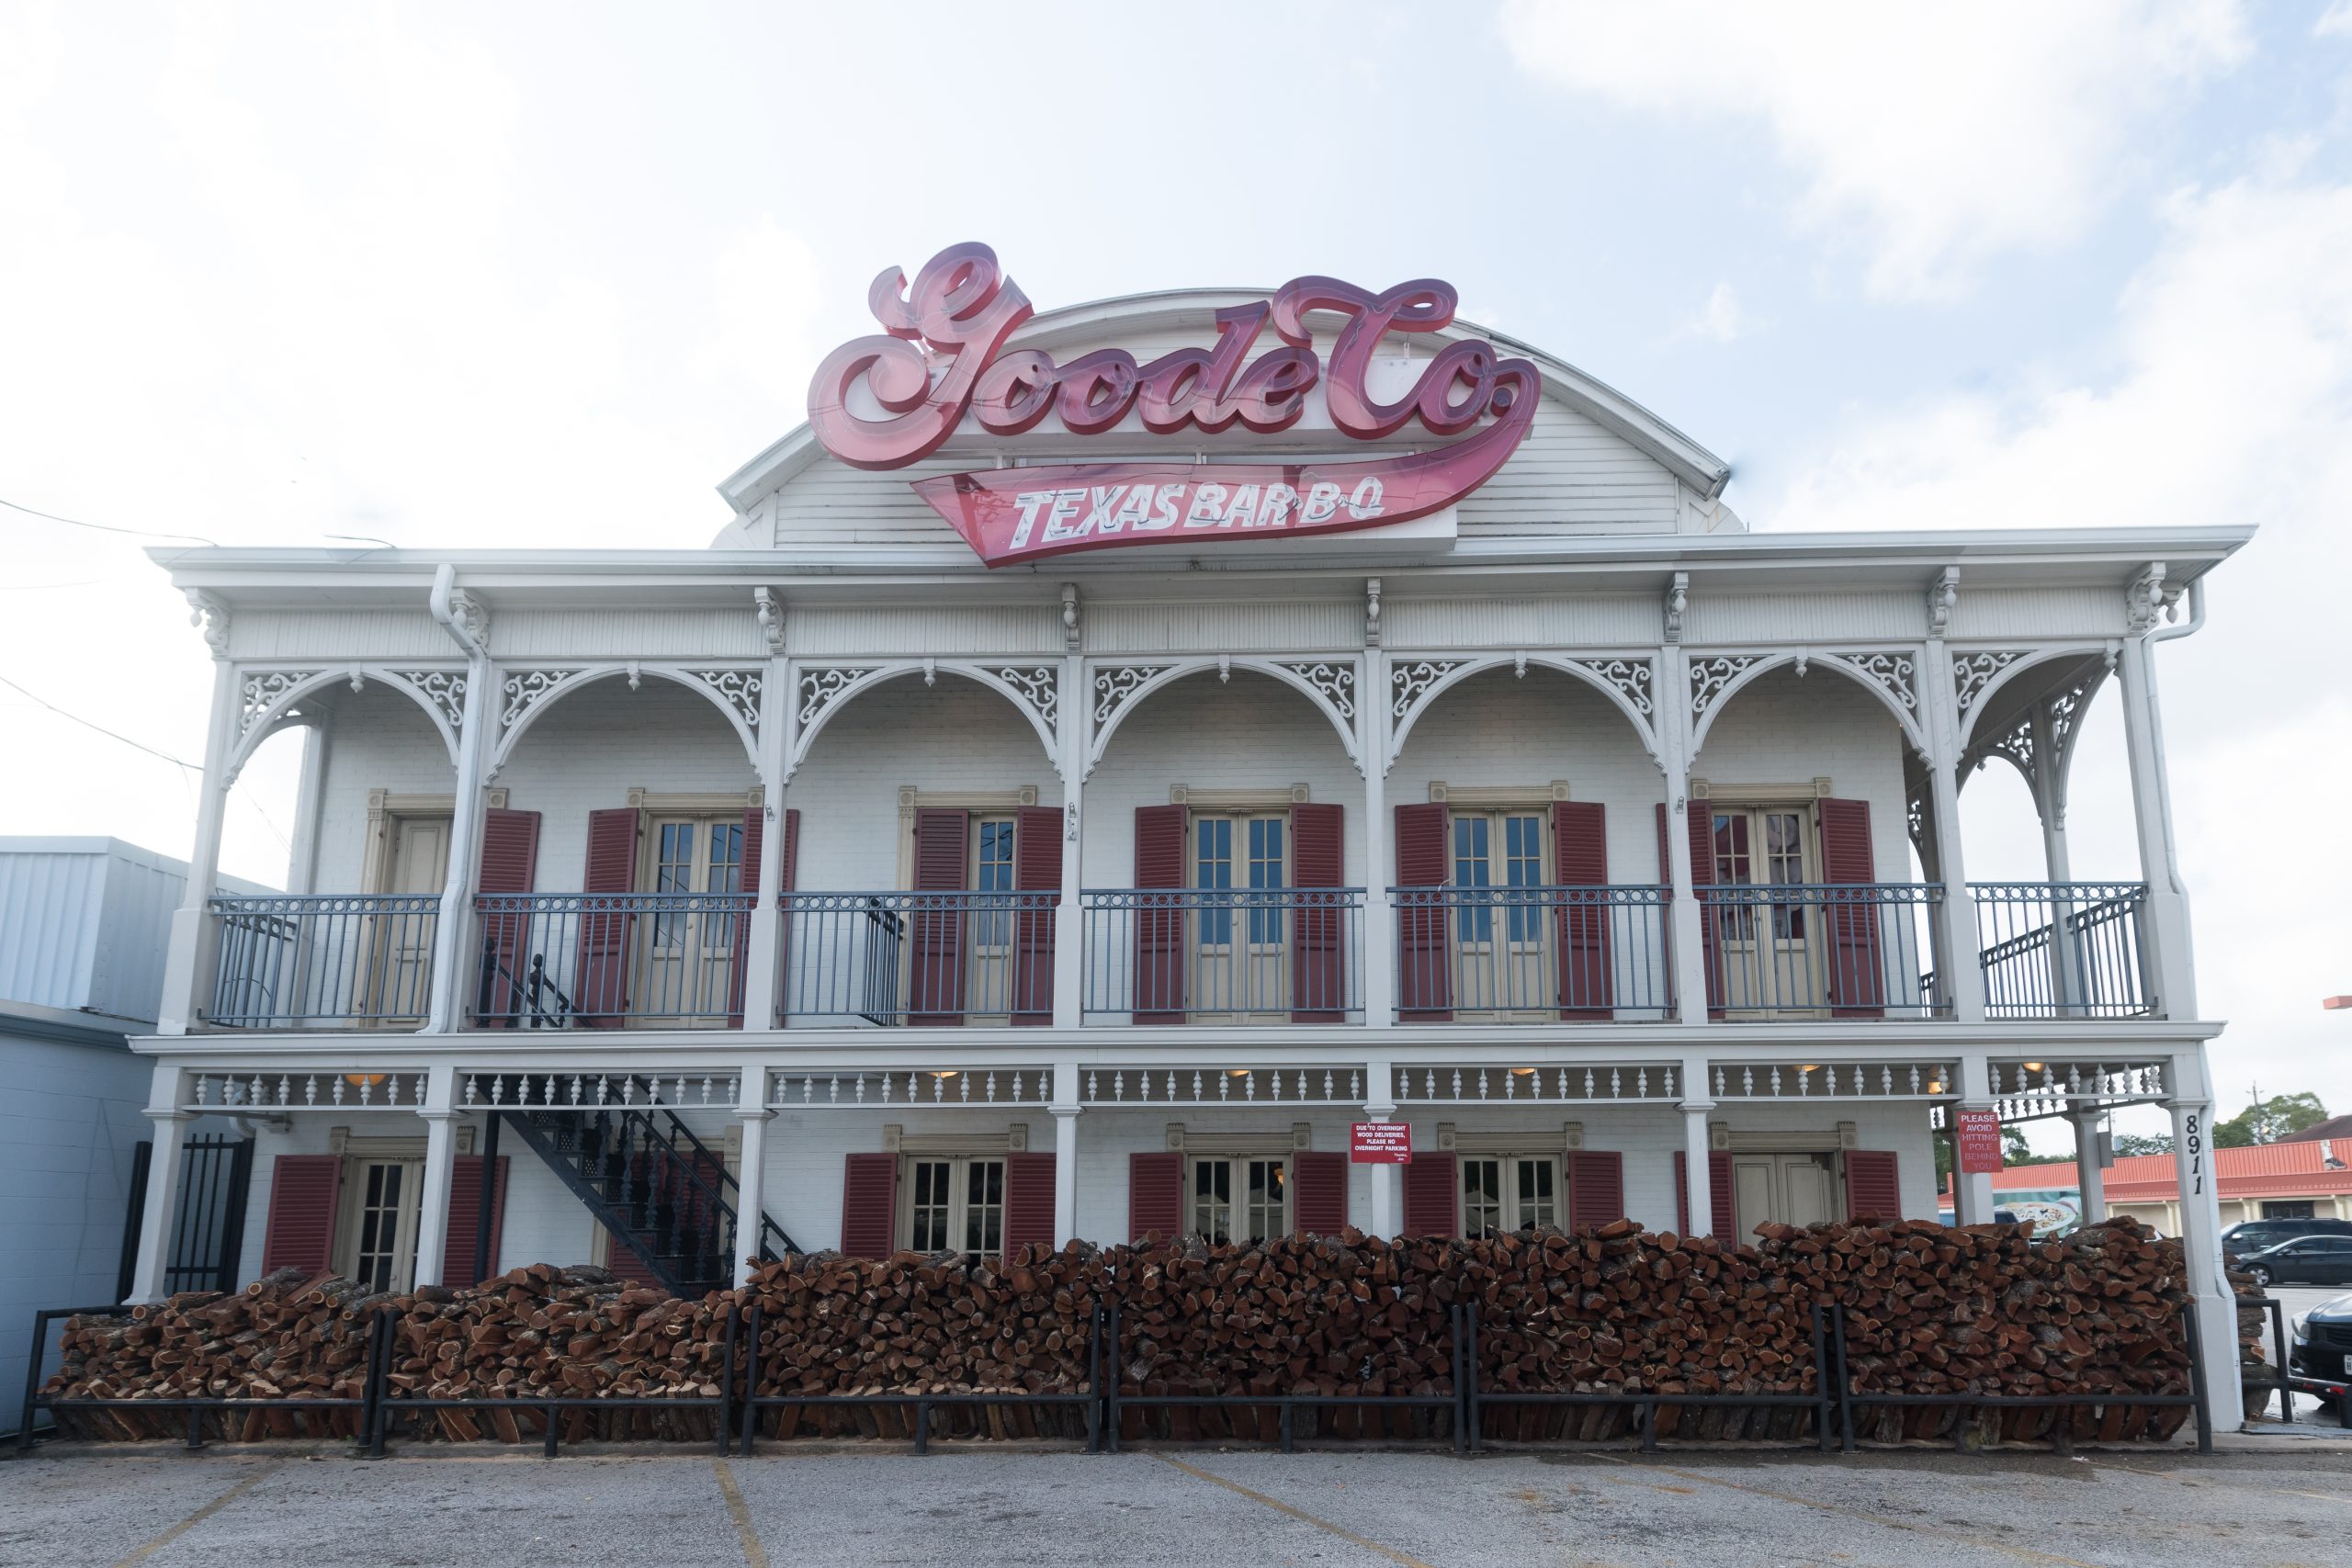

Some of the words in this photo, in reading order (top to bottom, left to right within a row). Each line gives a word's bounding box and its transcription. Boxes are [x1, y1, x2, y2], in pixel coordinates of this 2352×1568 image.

[807, 241, 1320, 471] Goode
[1009, 483, 1183, 549] TEXAS
[1961, 1114, 1996, 1122] PLEASE
[1962, 1134, 1997, 1142] HITTING
[1969, 1143, 1993, 1151] POLE
[2187, 1115, 2201, 1195] 8911
[1973, 1162, 1992, 1170] YOU
